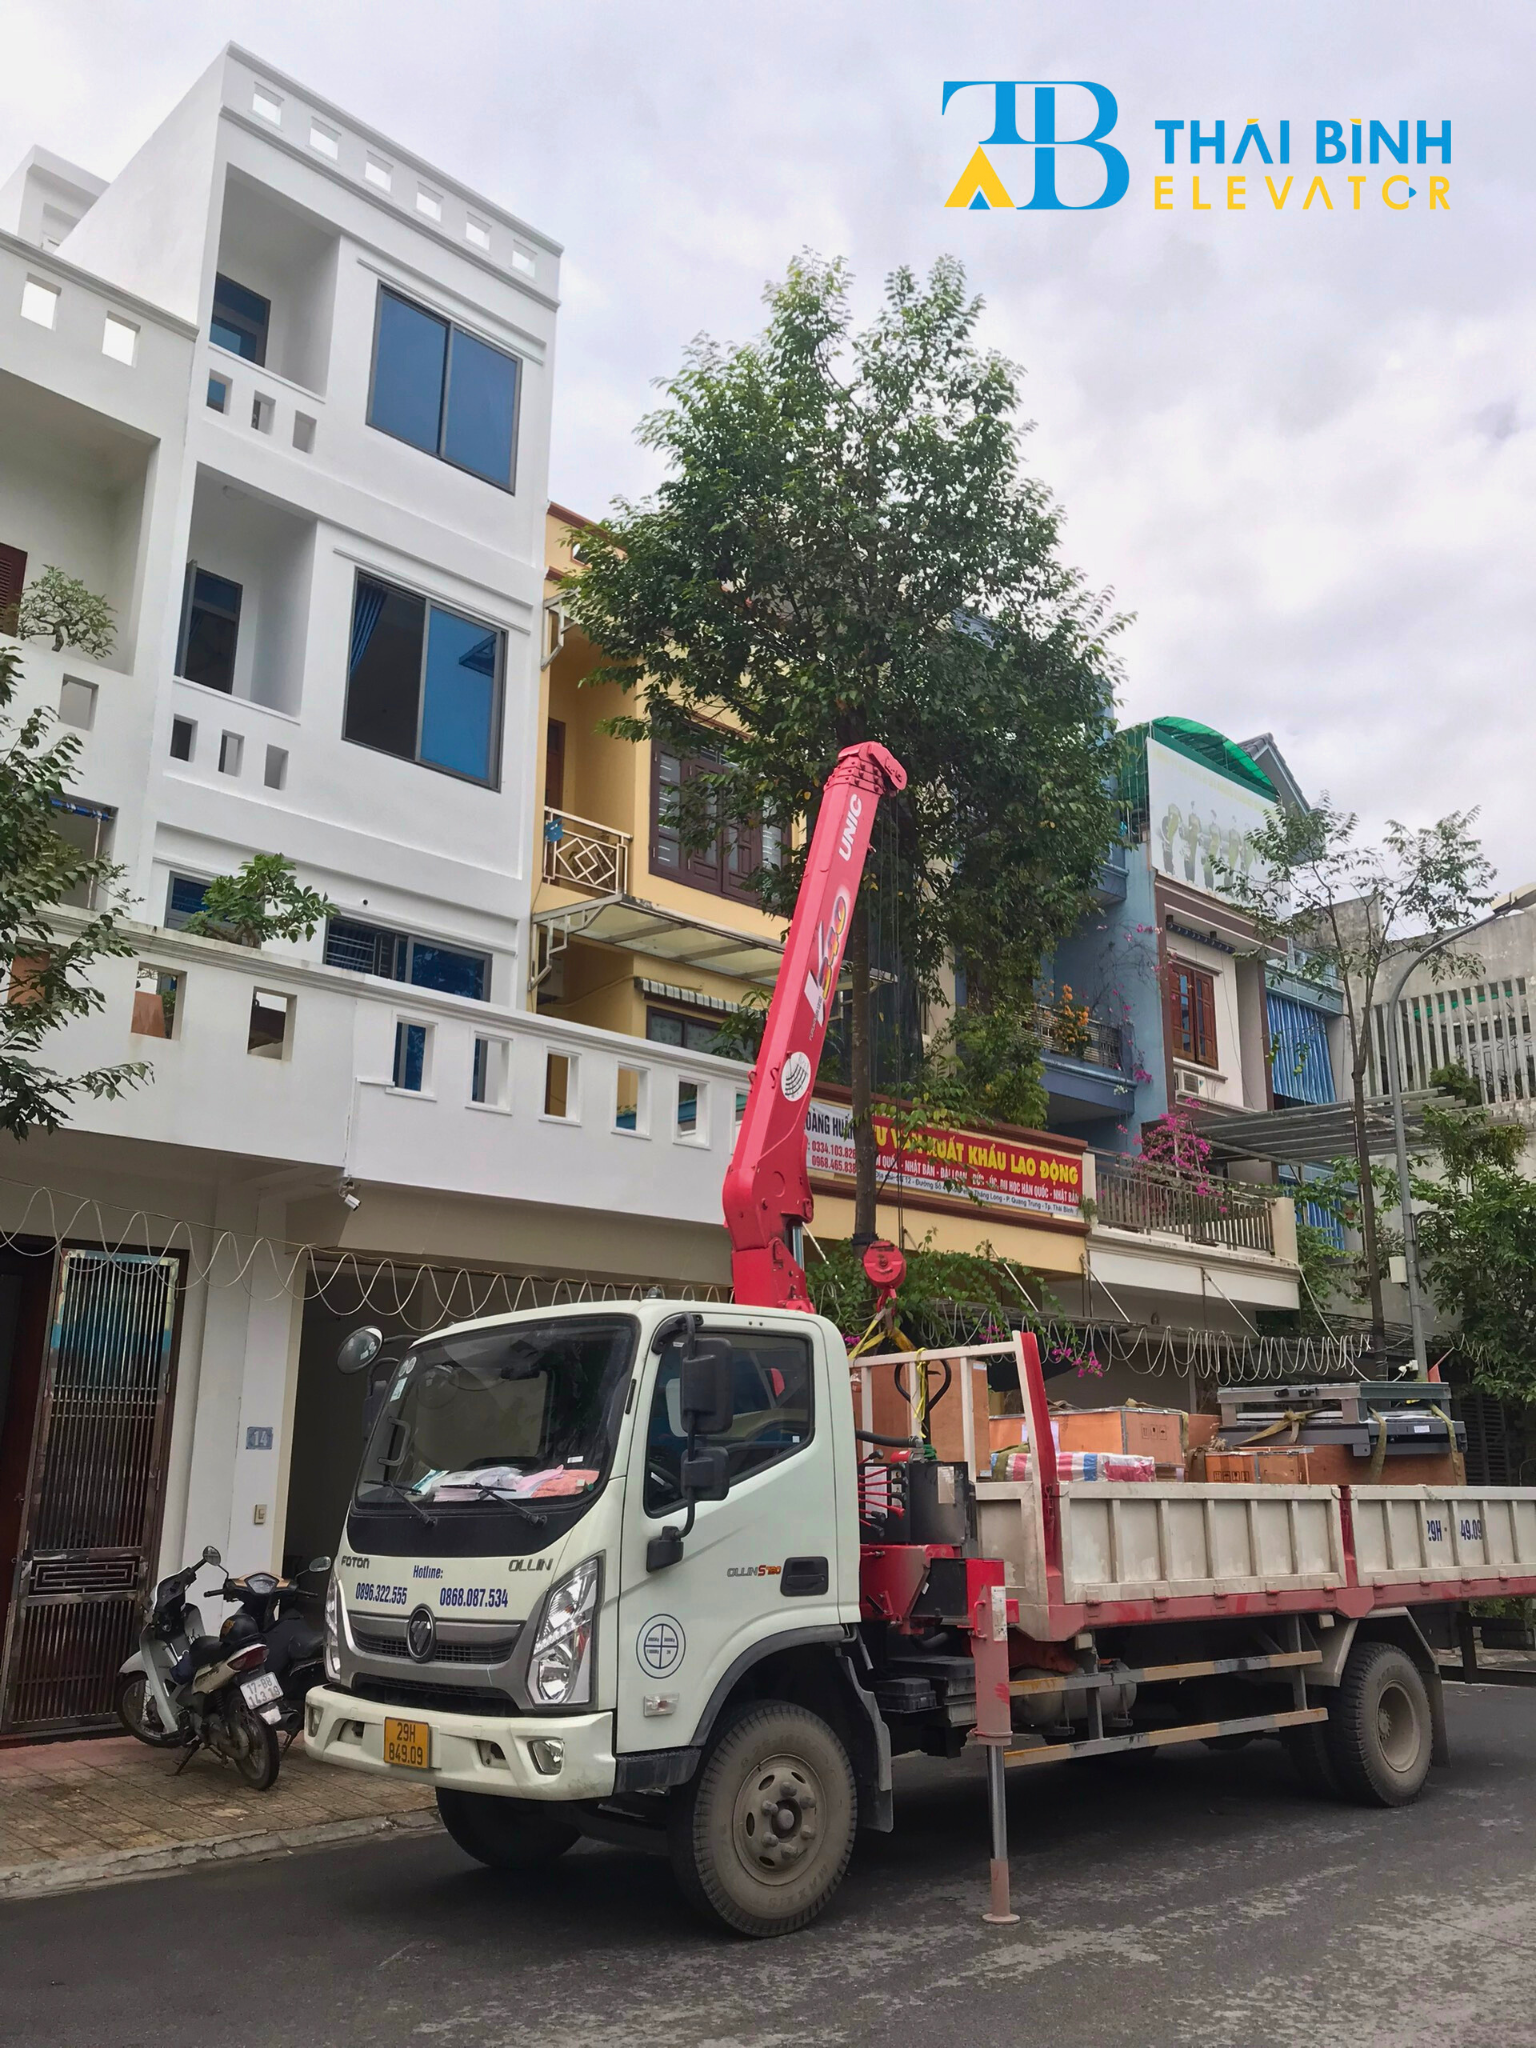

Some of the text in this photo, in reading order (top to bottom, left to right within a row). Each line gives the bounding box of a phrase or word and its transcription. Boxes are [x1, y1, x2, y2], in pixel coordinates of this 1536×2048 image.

[838, 793, 862, 862] UNIC
[804, 1107, 830, 1135] OÀNG
[968, 1143, 1006, 1171] KHẨU
[1010, 1153, 1036, 1177] LAO
[1040, 1158, 1079, 1186] ĐỘNG
[253, 1430, 268, 1447] 14
[340, 1555, 554, 1573] FOTON OLLIN
[412, 1565, 444, 1580] Hotline:
[355, 1582, 509, 1608] 0896.322.555 0868.087.534
[396, 1722, 416, 1743] 29H
[389, 1742, 423, 1766] 849.09
